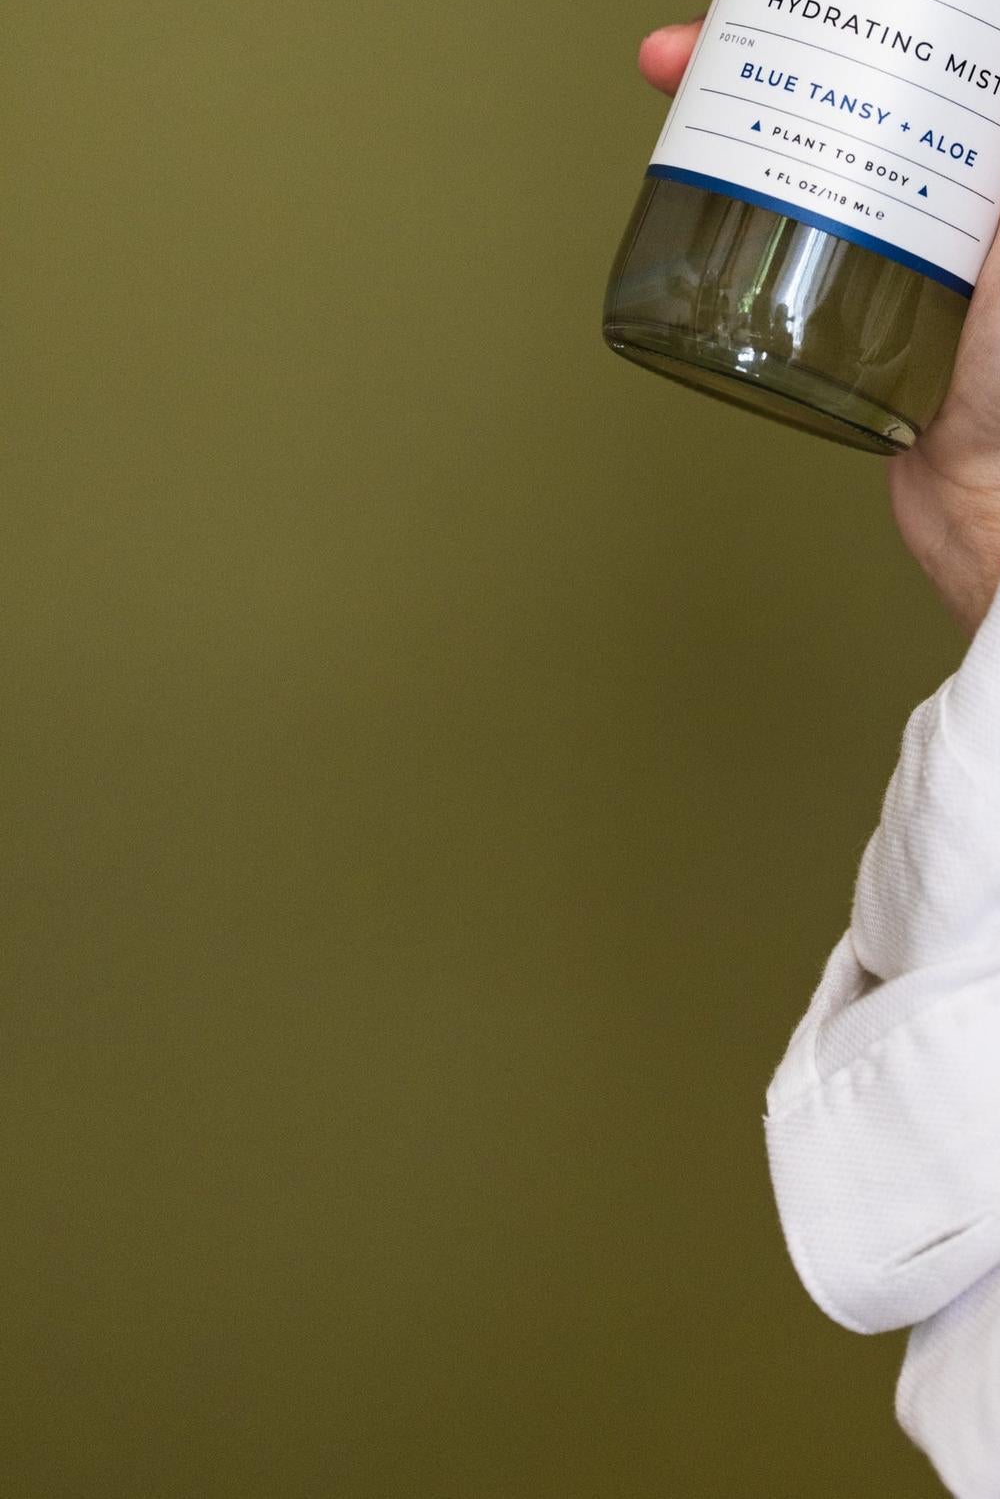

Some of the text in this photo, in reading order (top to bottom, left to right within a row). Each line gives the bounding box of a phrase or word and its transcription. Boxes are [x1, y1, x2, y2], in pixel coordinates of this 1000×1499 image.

[719, 32, 756, 48] POTION
[739, 61, 979, 168] BLUE TANSY + ALOE
[771, 126, 910, 187] PLANT TO BODY
[764, 168, 771, 178] 4
[776, 172, 791, 185] FL
